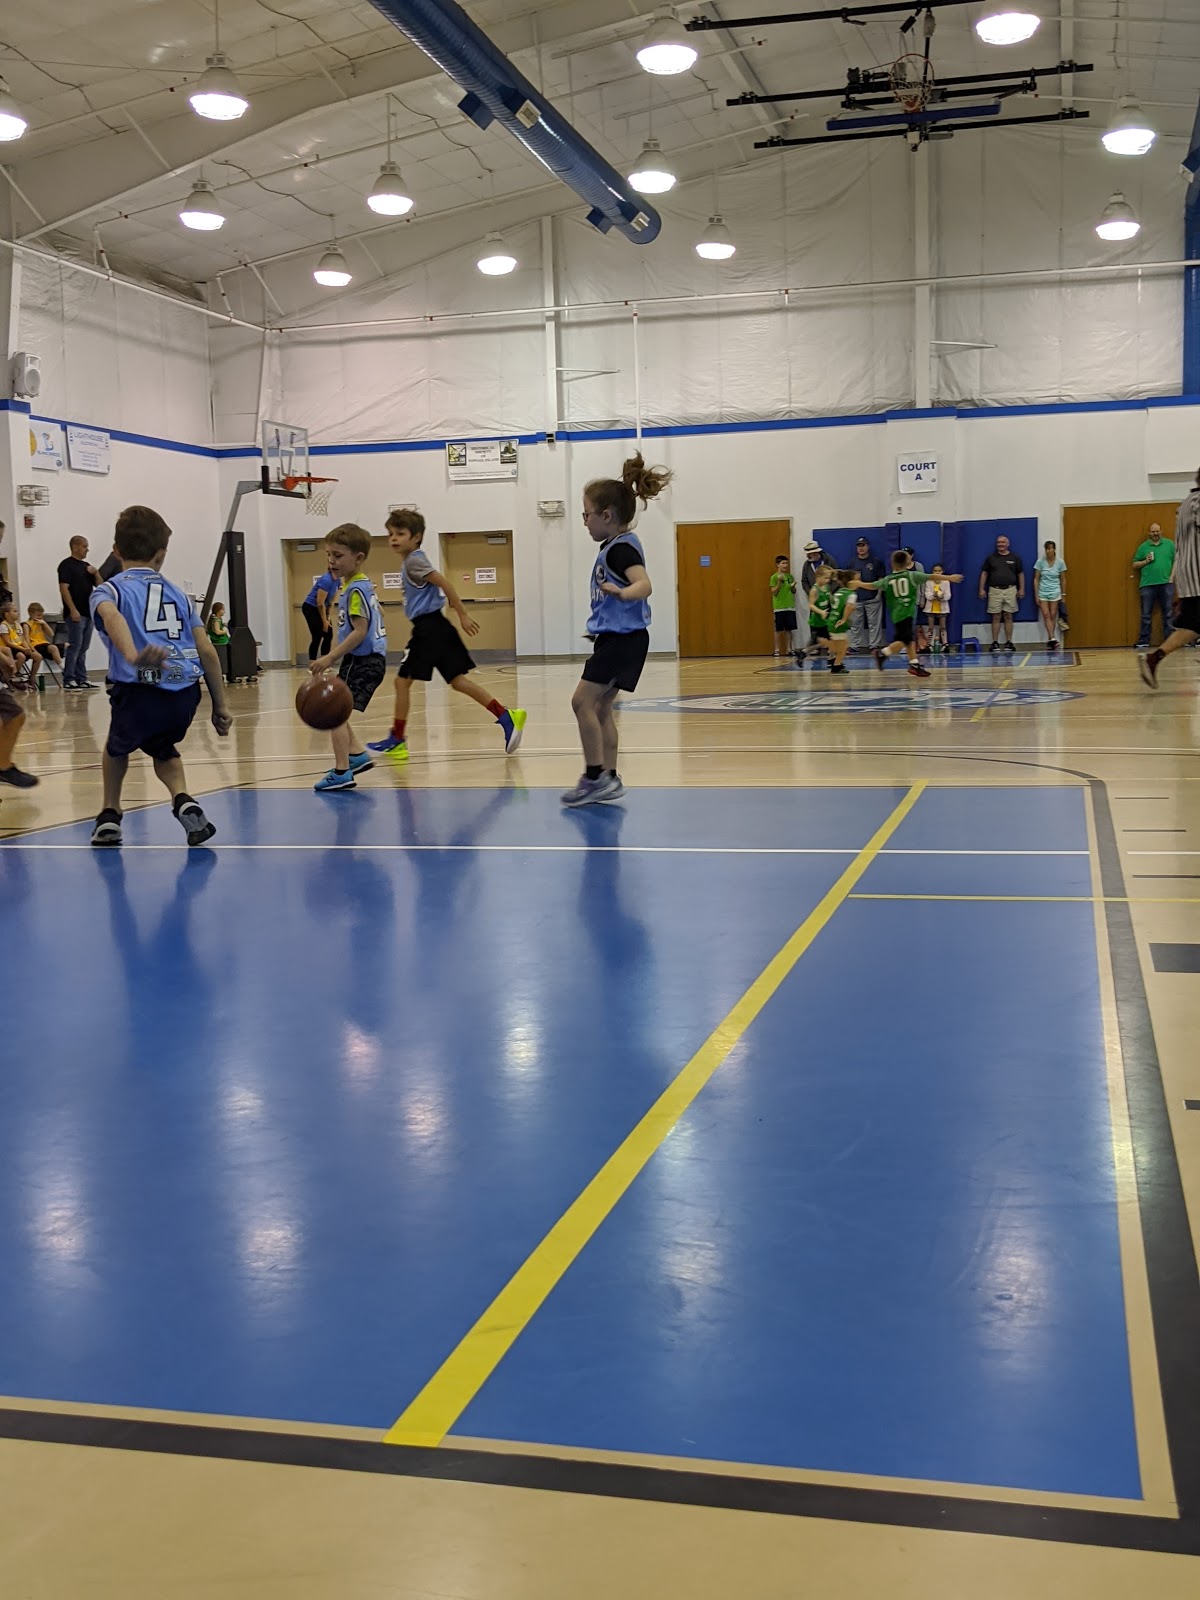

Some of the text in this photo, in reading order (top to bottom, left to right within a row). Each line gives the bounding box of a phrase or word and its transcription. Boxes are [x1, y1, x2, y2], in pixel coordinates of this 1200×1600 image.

[74, 432, 104, 442] LIGHTHOUSE
[900, 461, 937, 472] COURT
[915, 473, 923, 481] A
[889, 578, 910, 598] 10
[144, 582, 184, 640] 4
